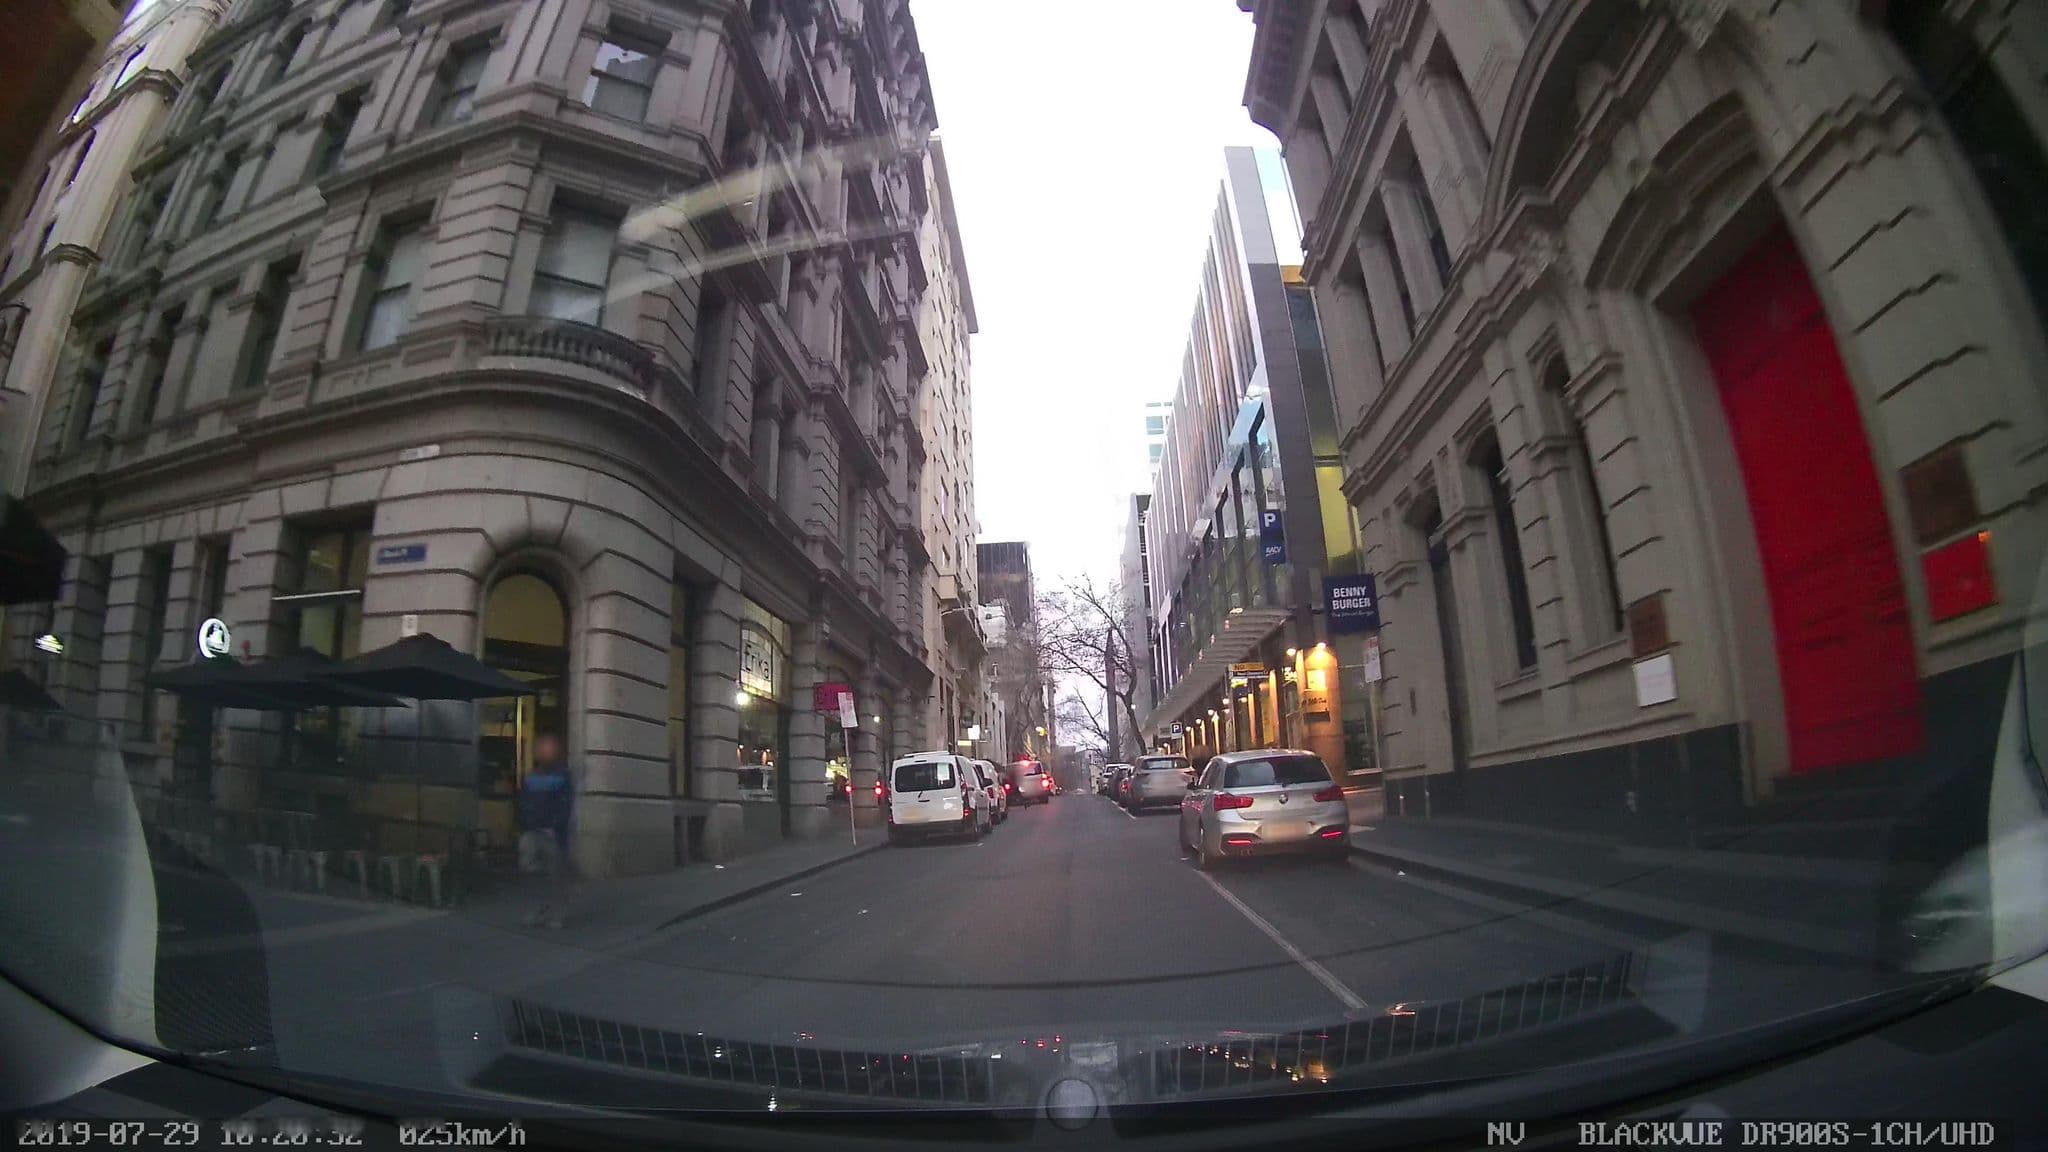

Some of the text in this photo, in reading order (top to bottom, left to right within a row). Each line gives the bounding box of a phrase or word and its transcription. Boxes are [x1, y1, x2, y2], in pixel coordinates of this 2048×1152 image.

[1264, 513, 1276, 528] P
[1333, 586, 1366, 598] BENNY
[1332, 597, 1371, 610] BURGER
[744, 642, 769, 680] Erika
[1173, 724, 1180, 733] P
